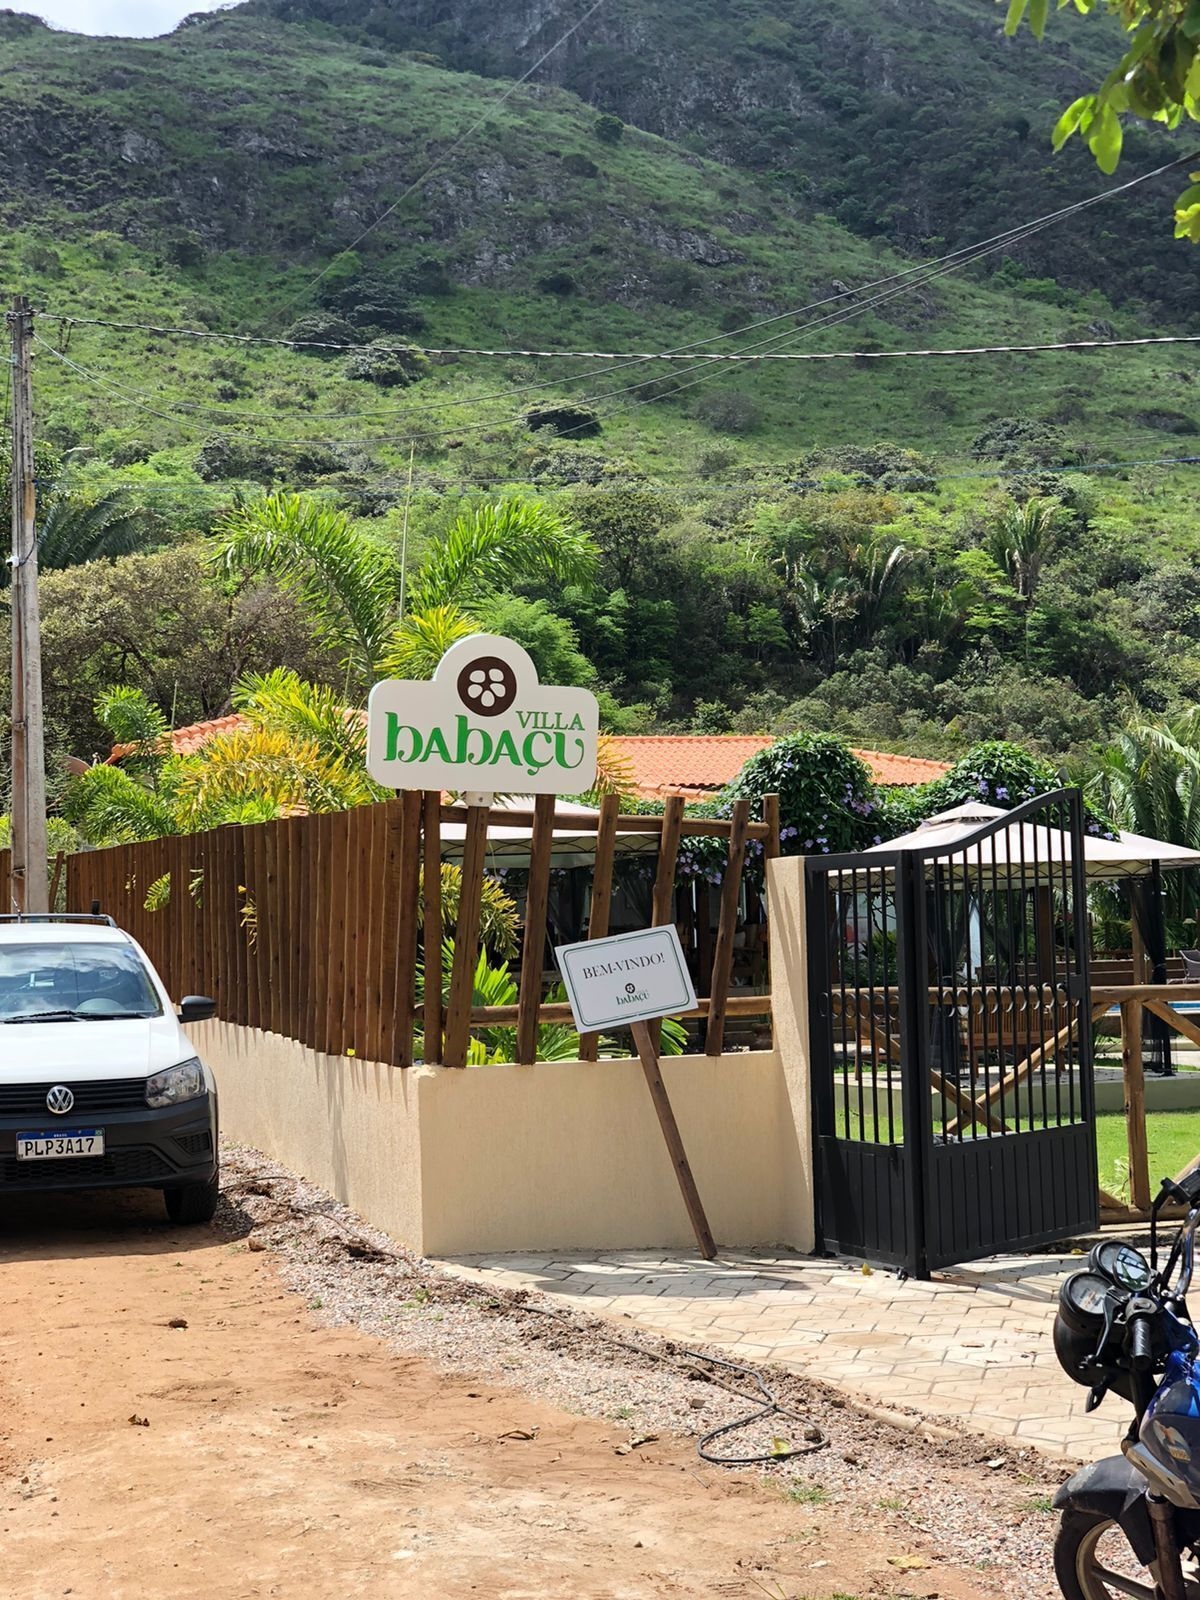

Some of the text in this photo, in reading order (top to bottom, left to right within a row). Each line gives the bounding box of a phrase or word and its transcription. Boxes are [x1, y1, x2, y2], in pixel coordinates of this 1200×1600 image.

[516, 711, 585, 731] VILLA
[582, 952, 665, 979] BEM-VINDO!
[25, 1138, 94, 1155] PLP3A17
